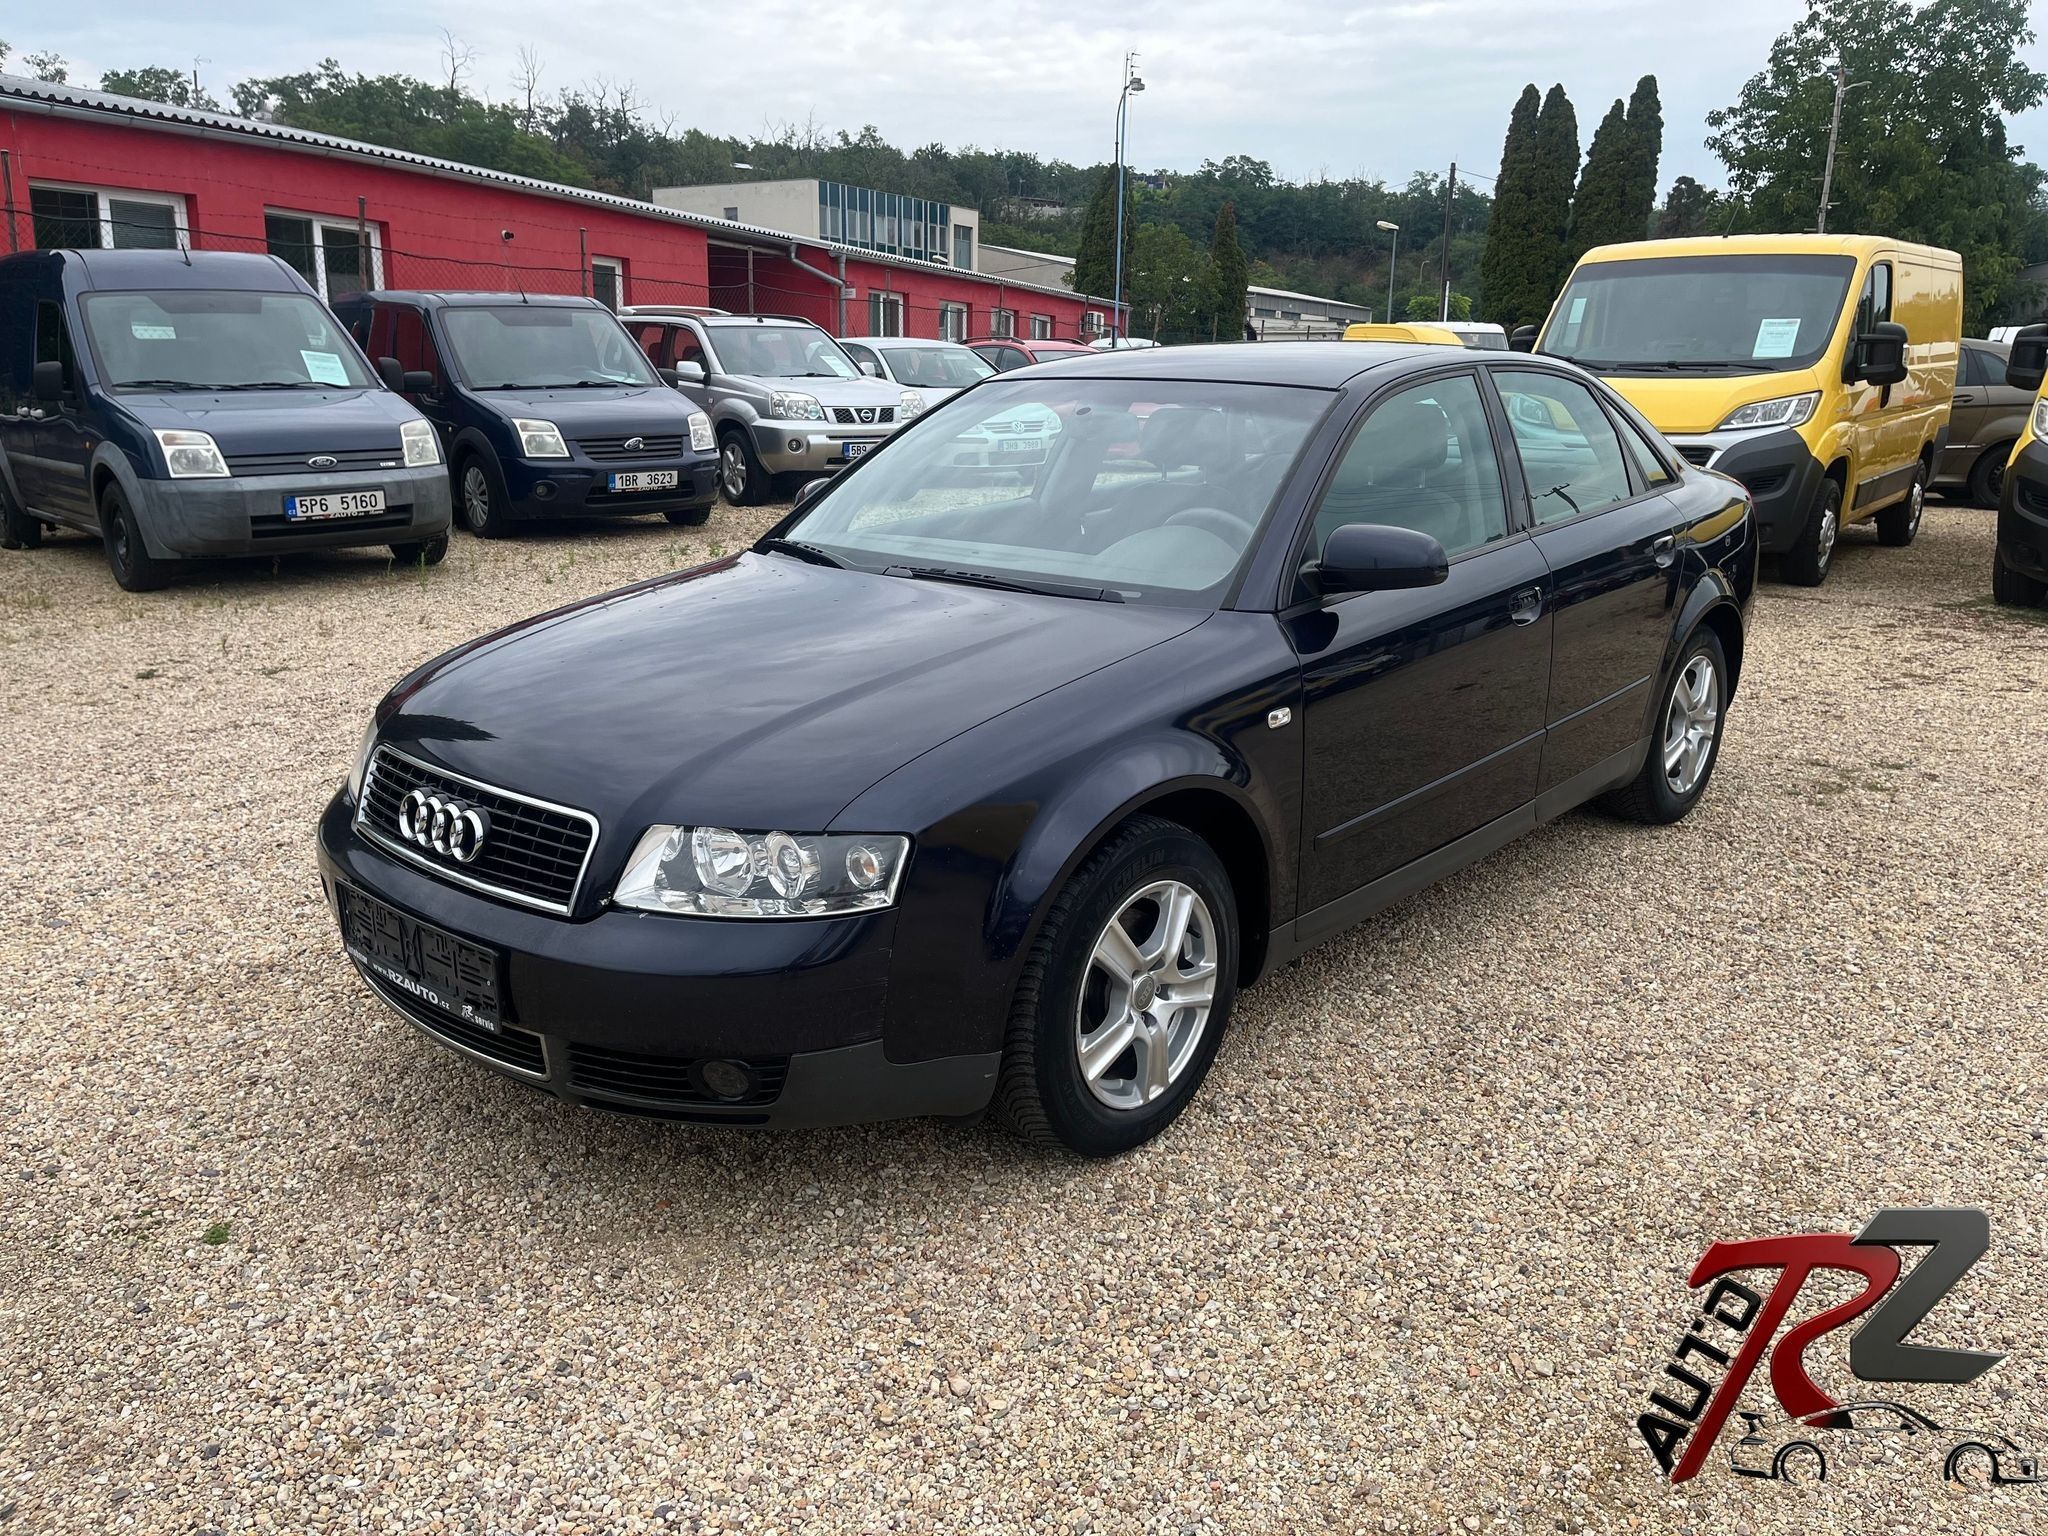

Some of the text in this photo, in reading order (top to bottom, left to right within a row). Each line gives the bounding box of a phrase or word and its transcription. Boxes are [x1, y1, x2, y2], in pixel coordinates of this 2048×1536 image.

[619, 475, 639, 487] 1BR
[647, 473, 673, 485] 3623
[300, 493, 378, 514] 5P6 5160
